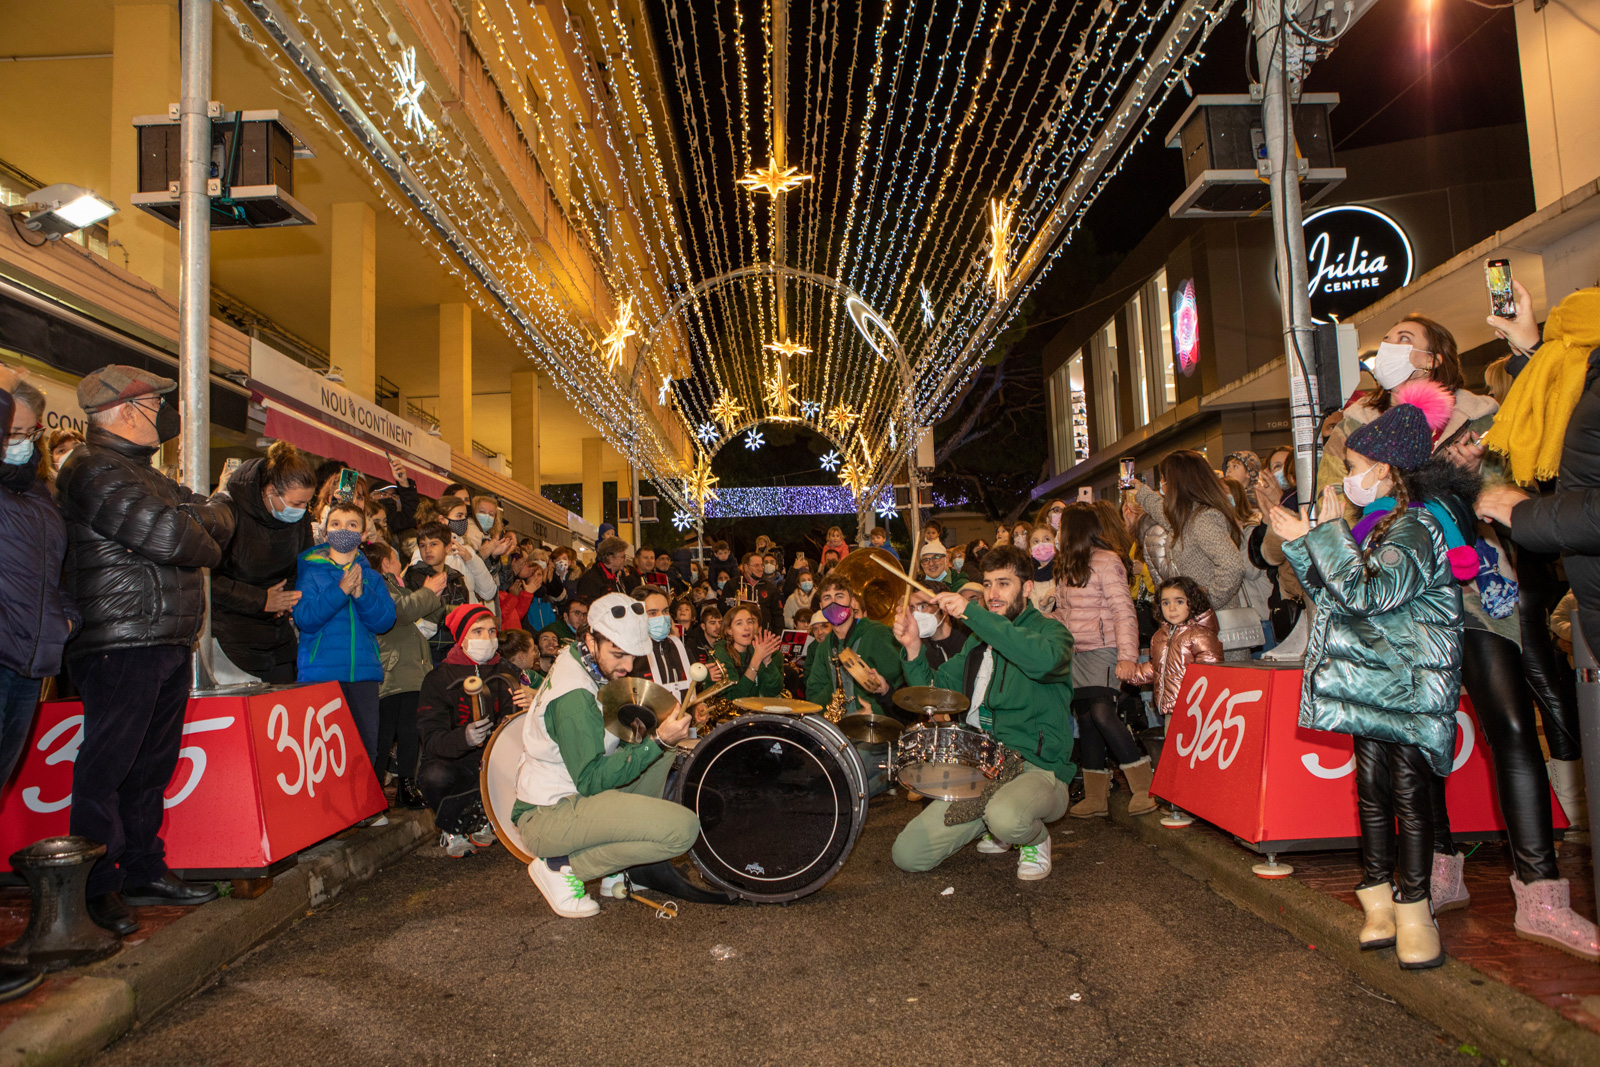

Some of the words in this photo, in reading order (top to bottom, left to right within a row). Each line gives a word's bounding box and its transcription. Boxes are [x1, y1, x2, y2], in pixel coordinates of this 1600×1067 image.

[1307, 232, 1389, 298] Júlia
[1324, 277, 1380, 293] CENTRE
[47, 411, 89, 434] CON
[321, 386, 347, 416] NOU
[357, 406, 413, 448] CONTINENT
[267, 697, 346, 798] 365
[1176, 676, 1263, 770] 365
